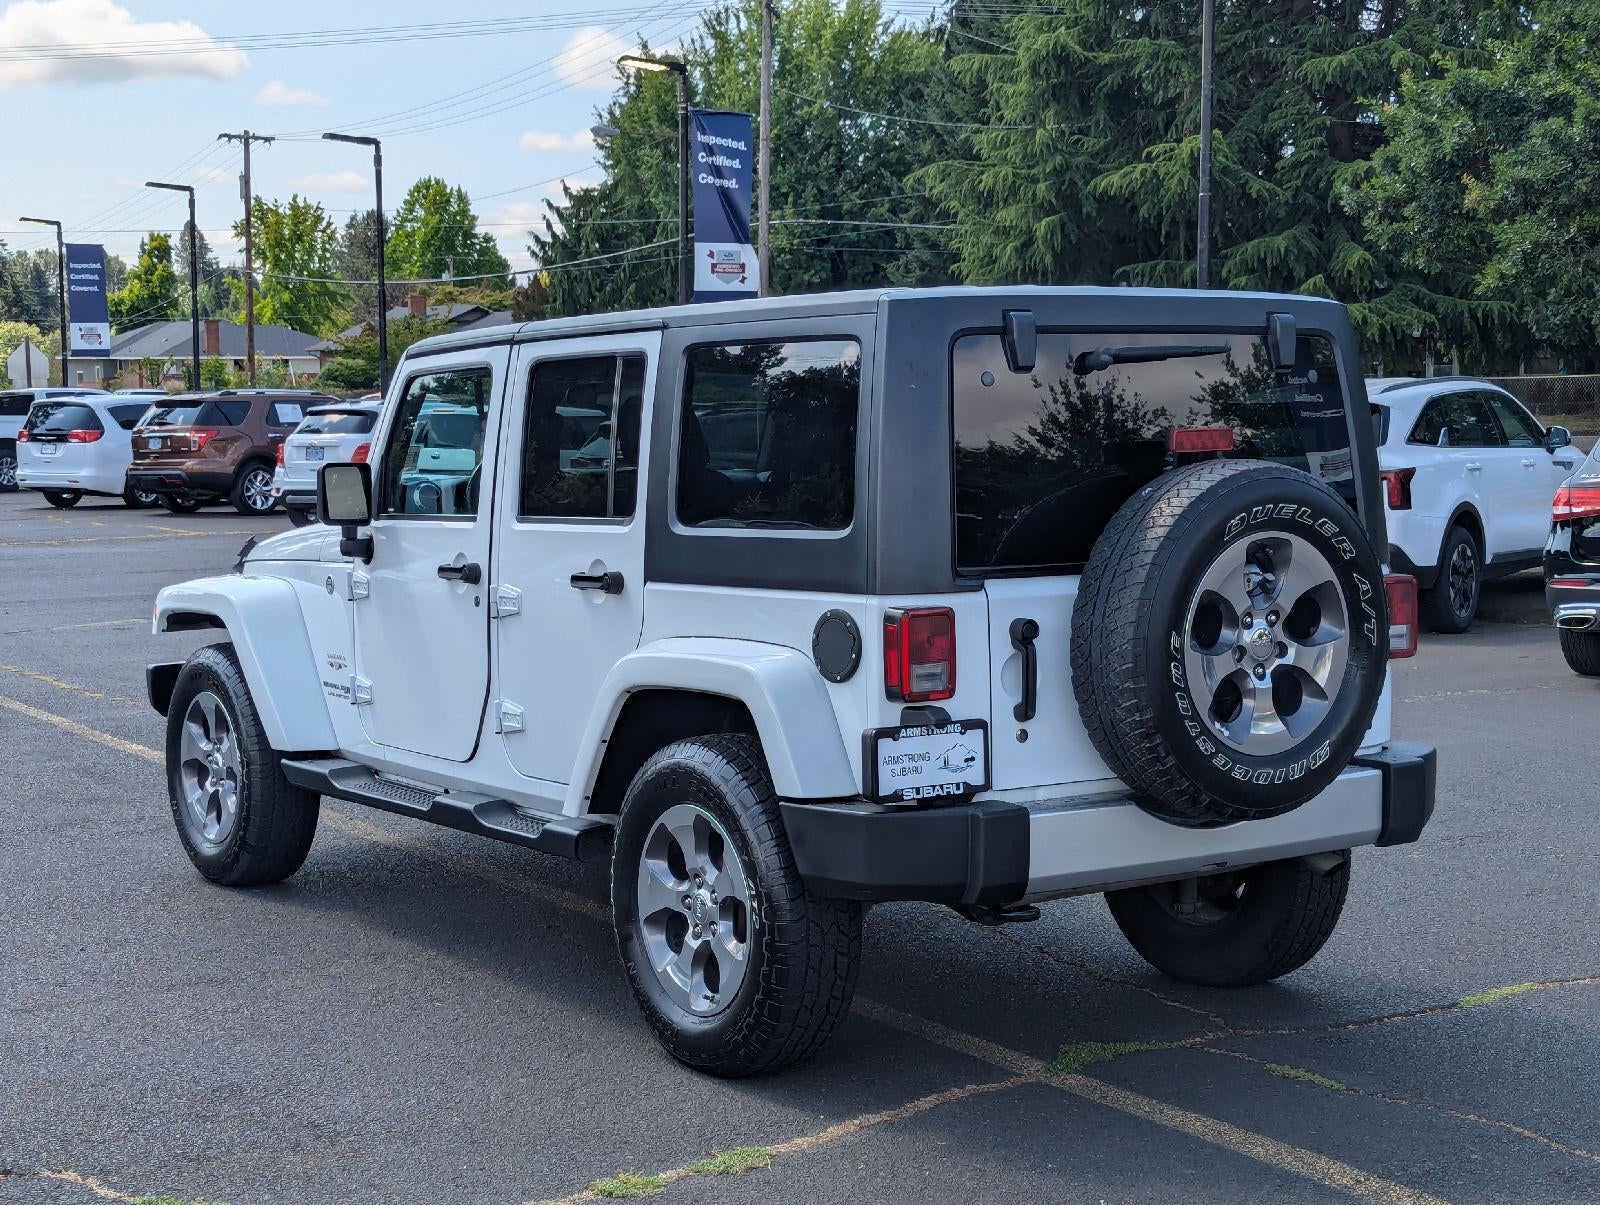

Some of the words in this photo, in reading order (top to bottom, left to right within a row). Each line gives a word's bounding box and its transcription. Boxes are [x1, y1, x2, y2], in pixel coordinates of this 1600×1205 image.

[1224, 503, 1358, 561] DUELER
[1352, 572, 1378, 648] A/T
[1168, 631, 1332, 786] BRIDGESTONE
[882, 752, 931, 767] ARMSTRONG
[891, 766, 922, 778] SUBARU
[903, 783, 963, 800] SUBARU
